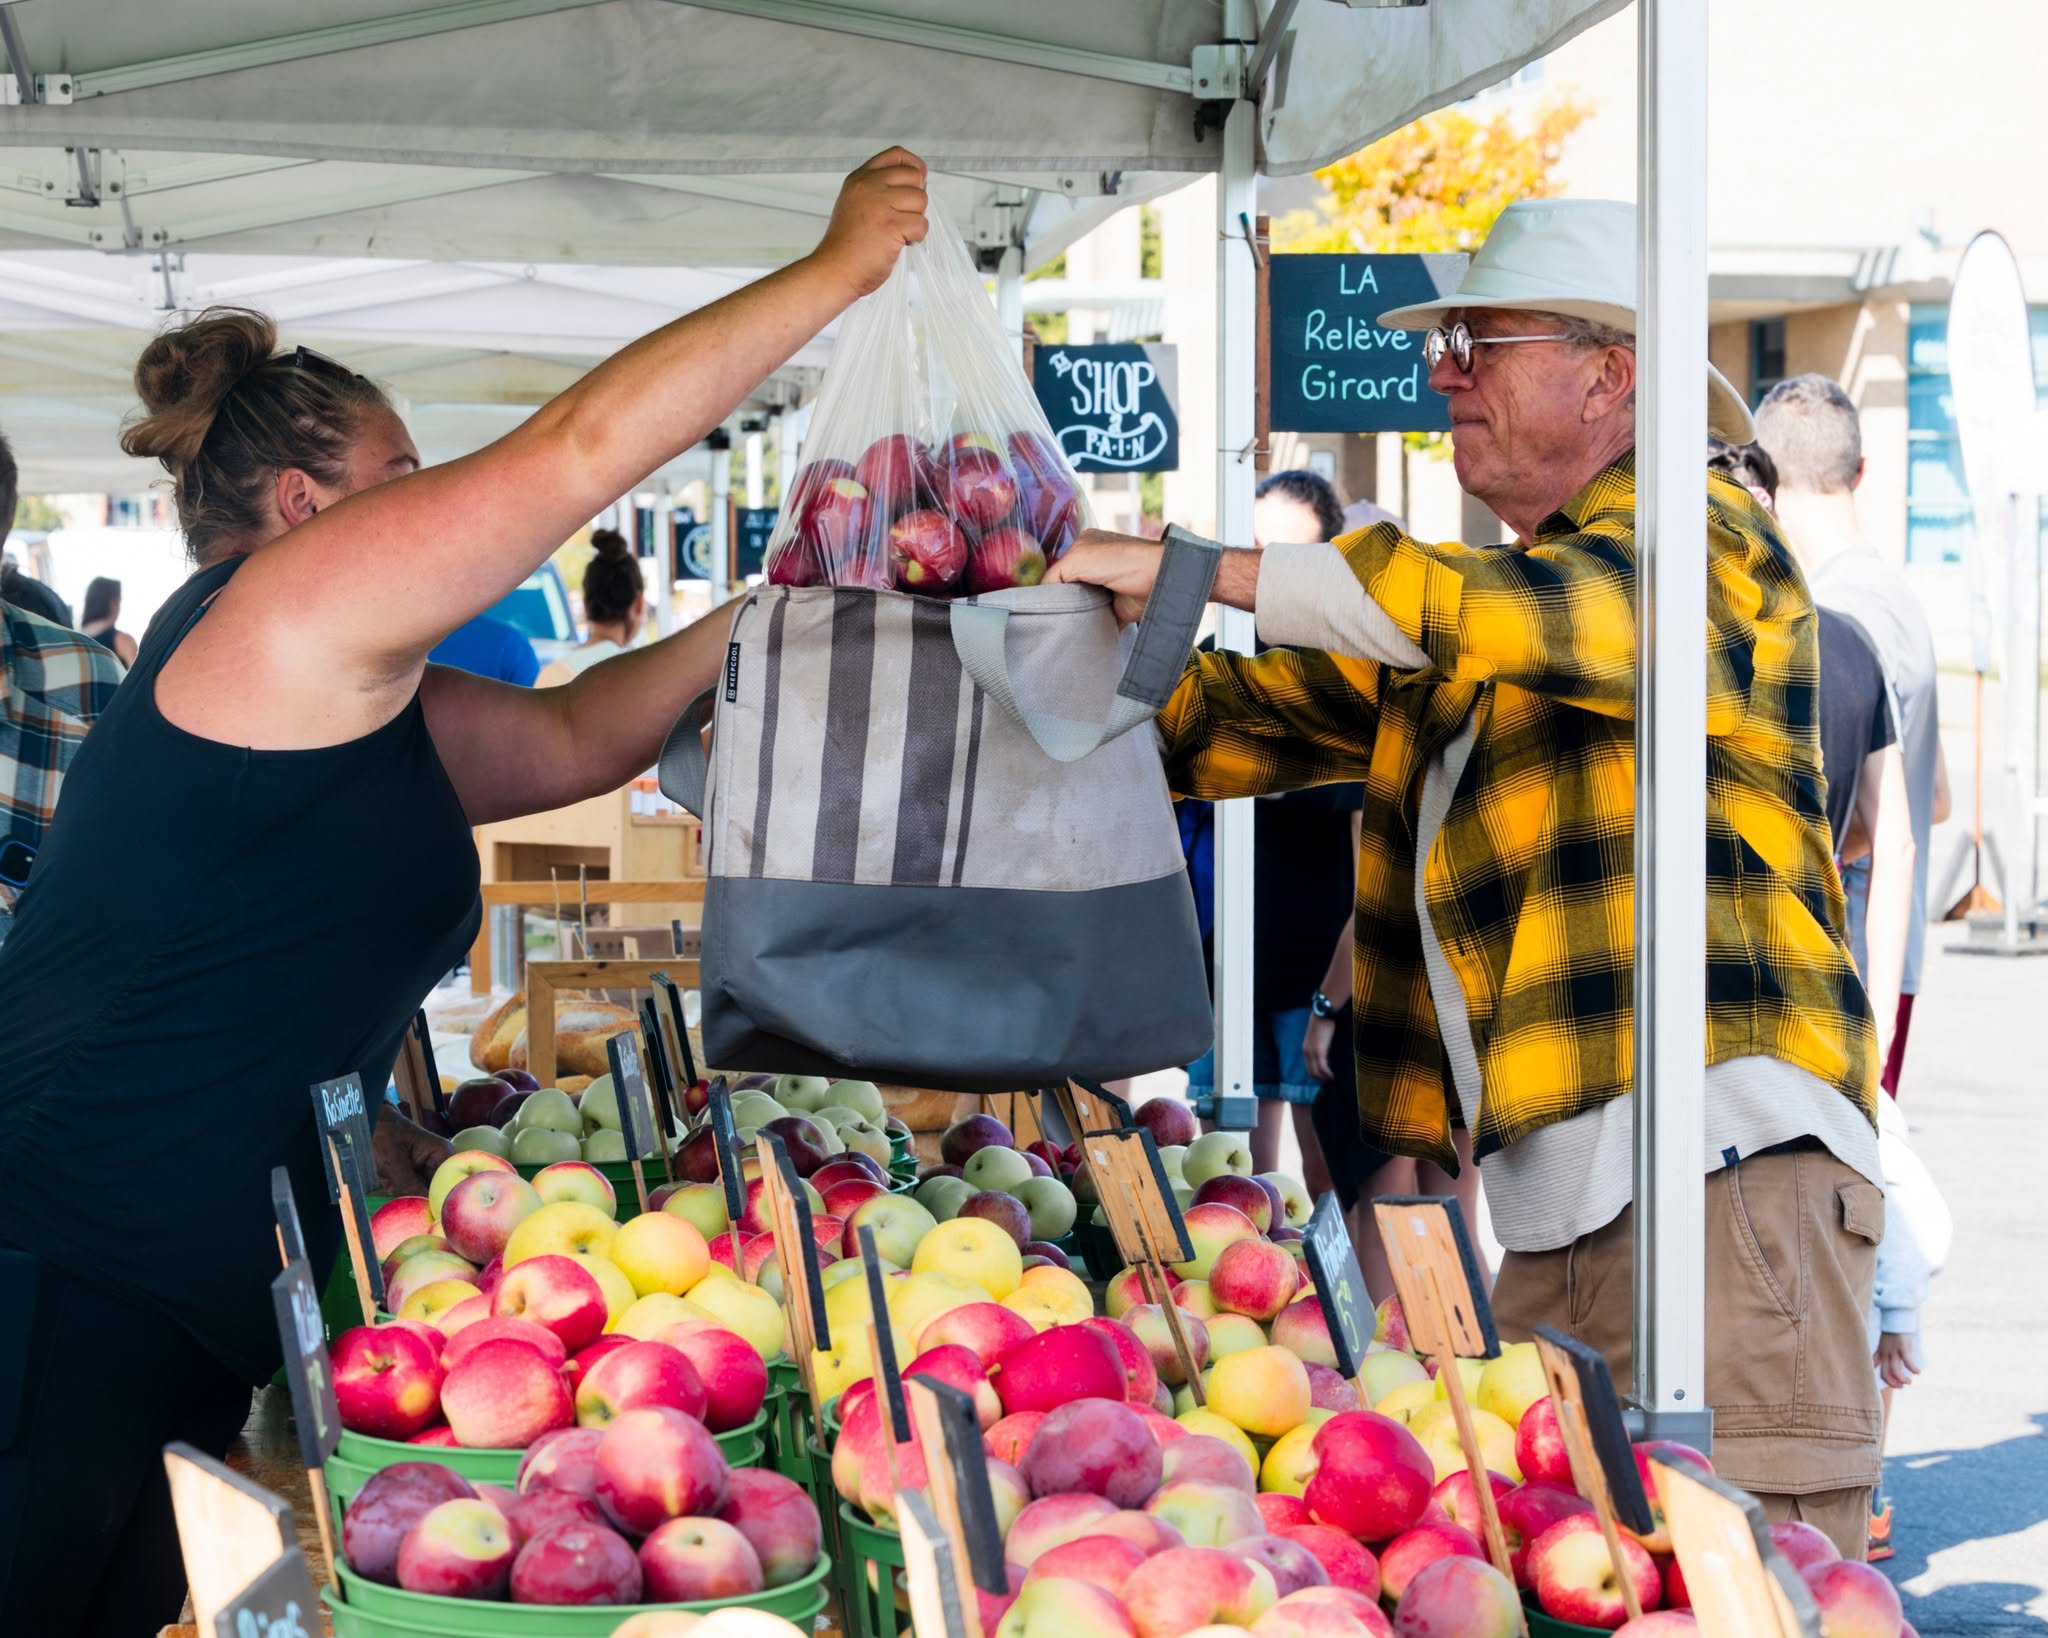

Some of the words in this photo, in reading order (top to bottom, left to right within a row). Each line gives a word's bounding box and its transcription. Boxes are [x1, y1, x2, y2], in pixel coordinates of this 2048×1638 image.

[1340, 263, 1379, 295] LA
[1304, 308, 1412, 351] Relève
[1070, 357, 1156, 416] SHOP
[1301, 363, 1418, 403] Girard
[729, 645, 739, 687] KEEPCOOL
